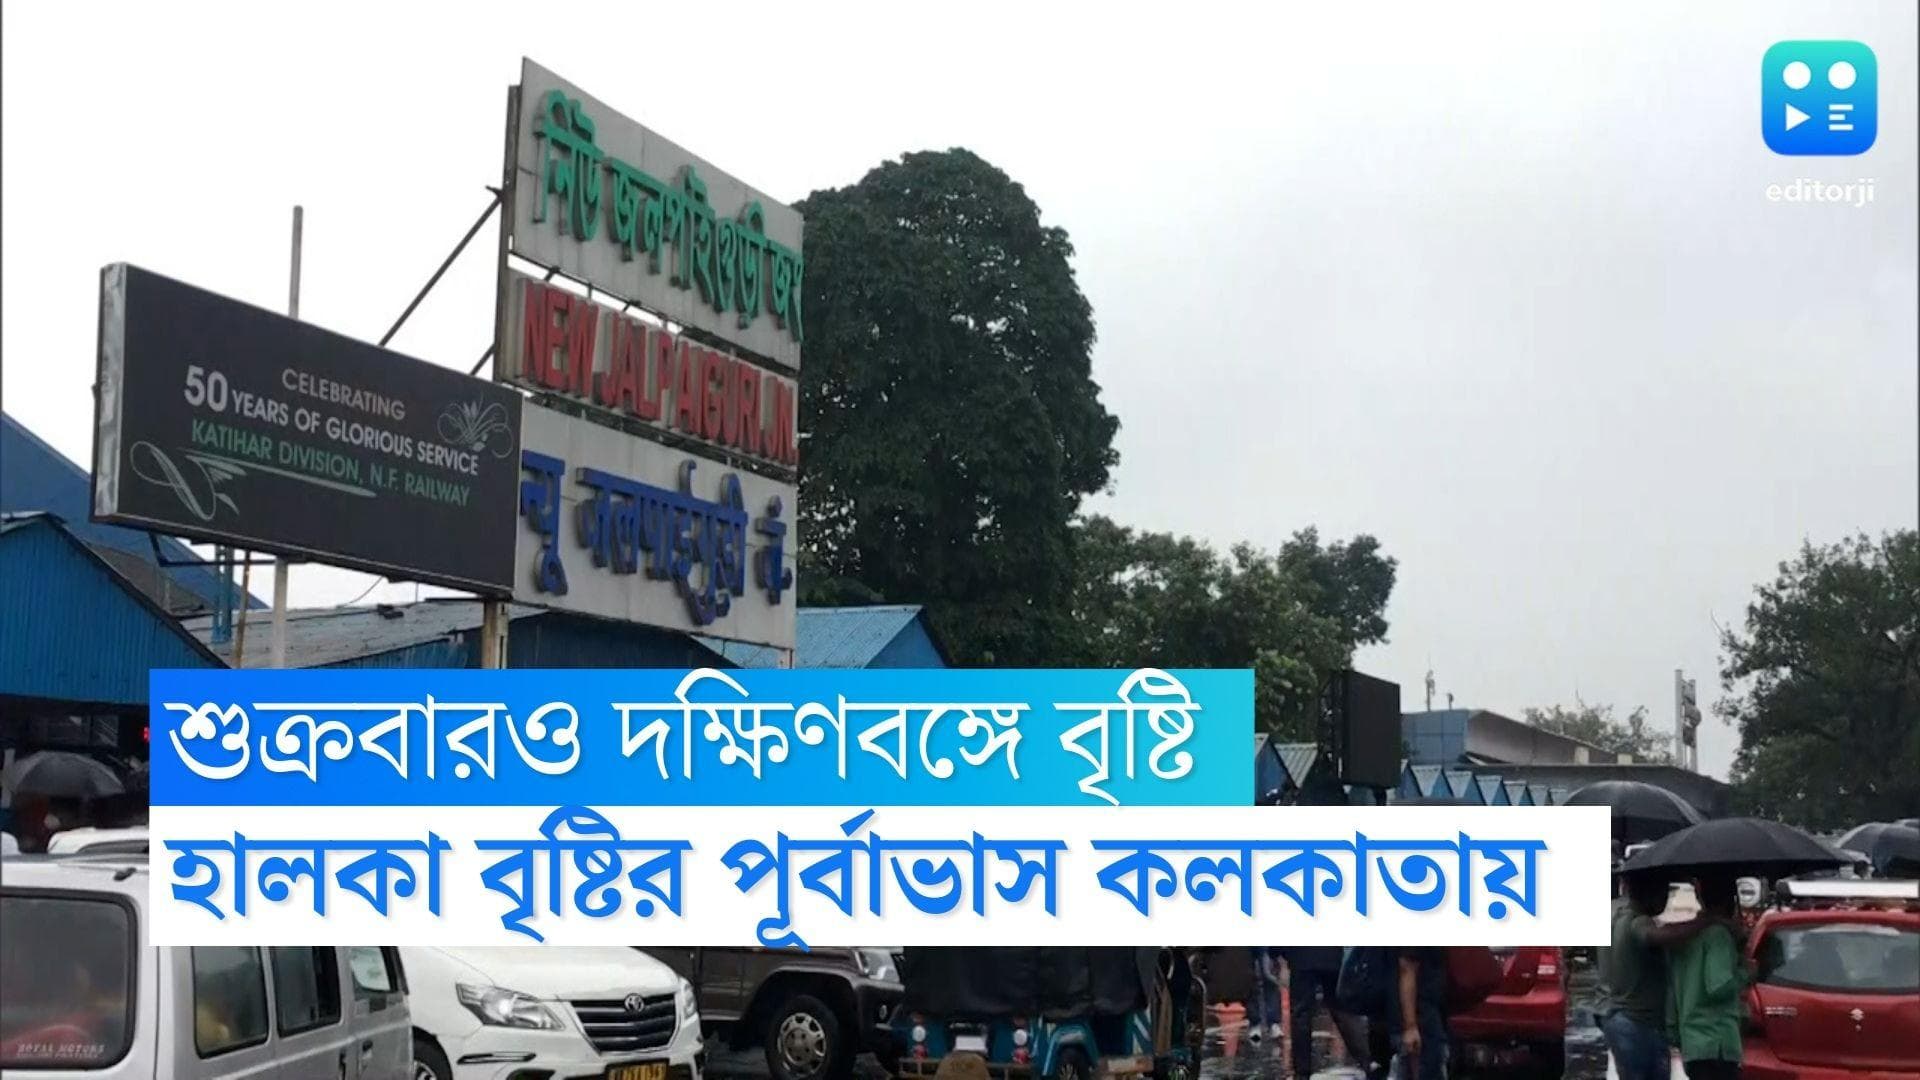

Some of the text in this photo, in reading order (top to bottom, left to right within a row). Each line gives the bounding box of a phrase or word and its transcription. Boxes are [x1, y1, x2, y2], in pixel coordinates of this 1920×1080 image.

[536, 88, 605, 241] নিউ
[184, 364, 479, 476] 50 YEARS OF GLORIOUS SERVICE
[281, 368, 406, 421] CELEBRATING
[519, 278, 600, 399] NEW
[596, 308, 762, 457] JALPAIGURI
[191, 418, 273, 461] KATIHAR
[278, 440, 364, 485] DIVISION,
[404, 471, 471, 508] RAILWAY
